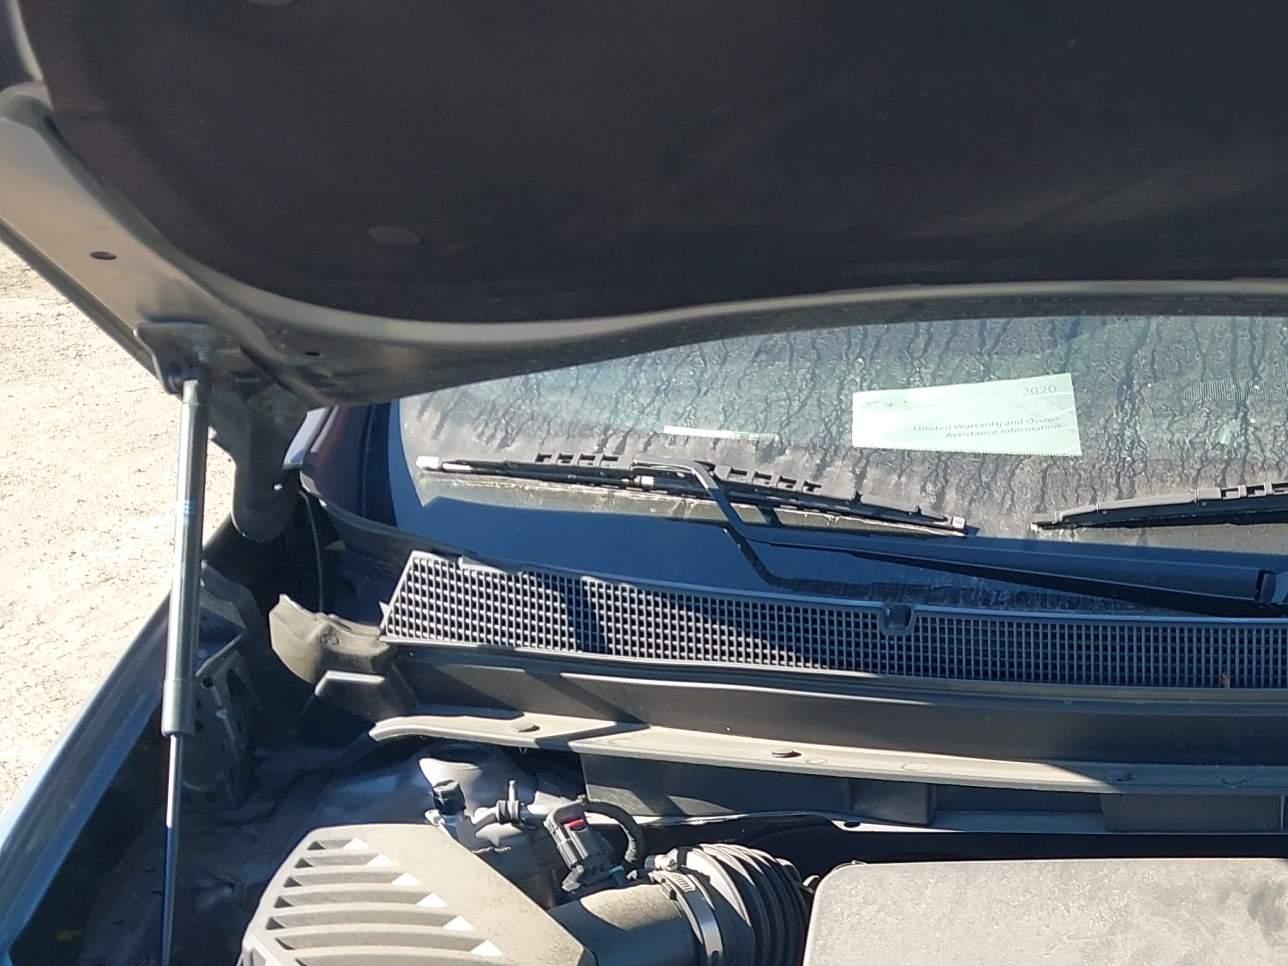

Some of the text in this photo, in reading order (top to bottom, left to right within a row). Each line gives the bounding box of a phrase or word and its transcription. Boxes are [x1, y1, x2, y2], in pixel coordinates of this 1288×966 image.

[1021, 385, 1057, 396] 2020
[913, 416, 1060, 432] Limited Warranty and Owner
[945, 429, 999, 438] Assistance
